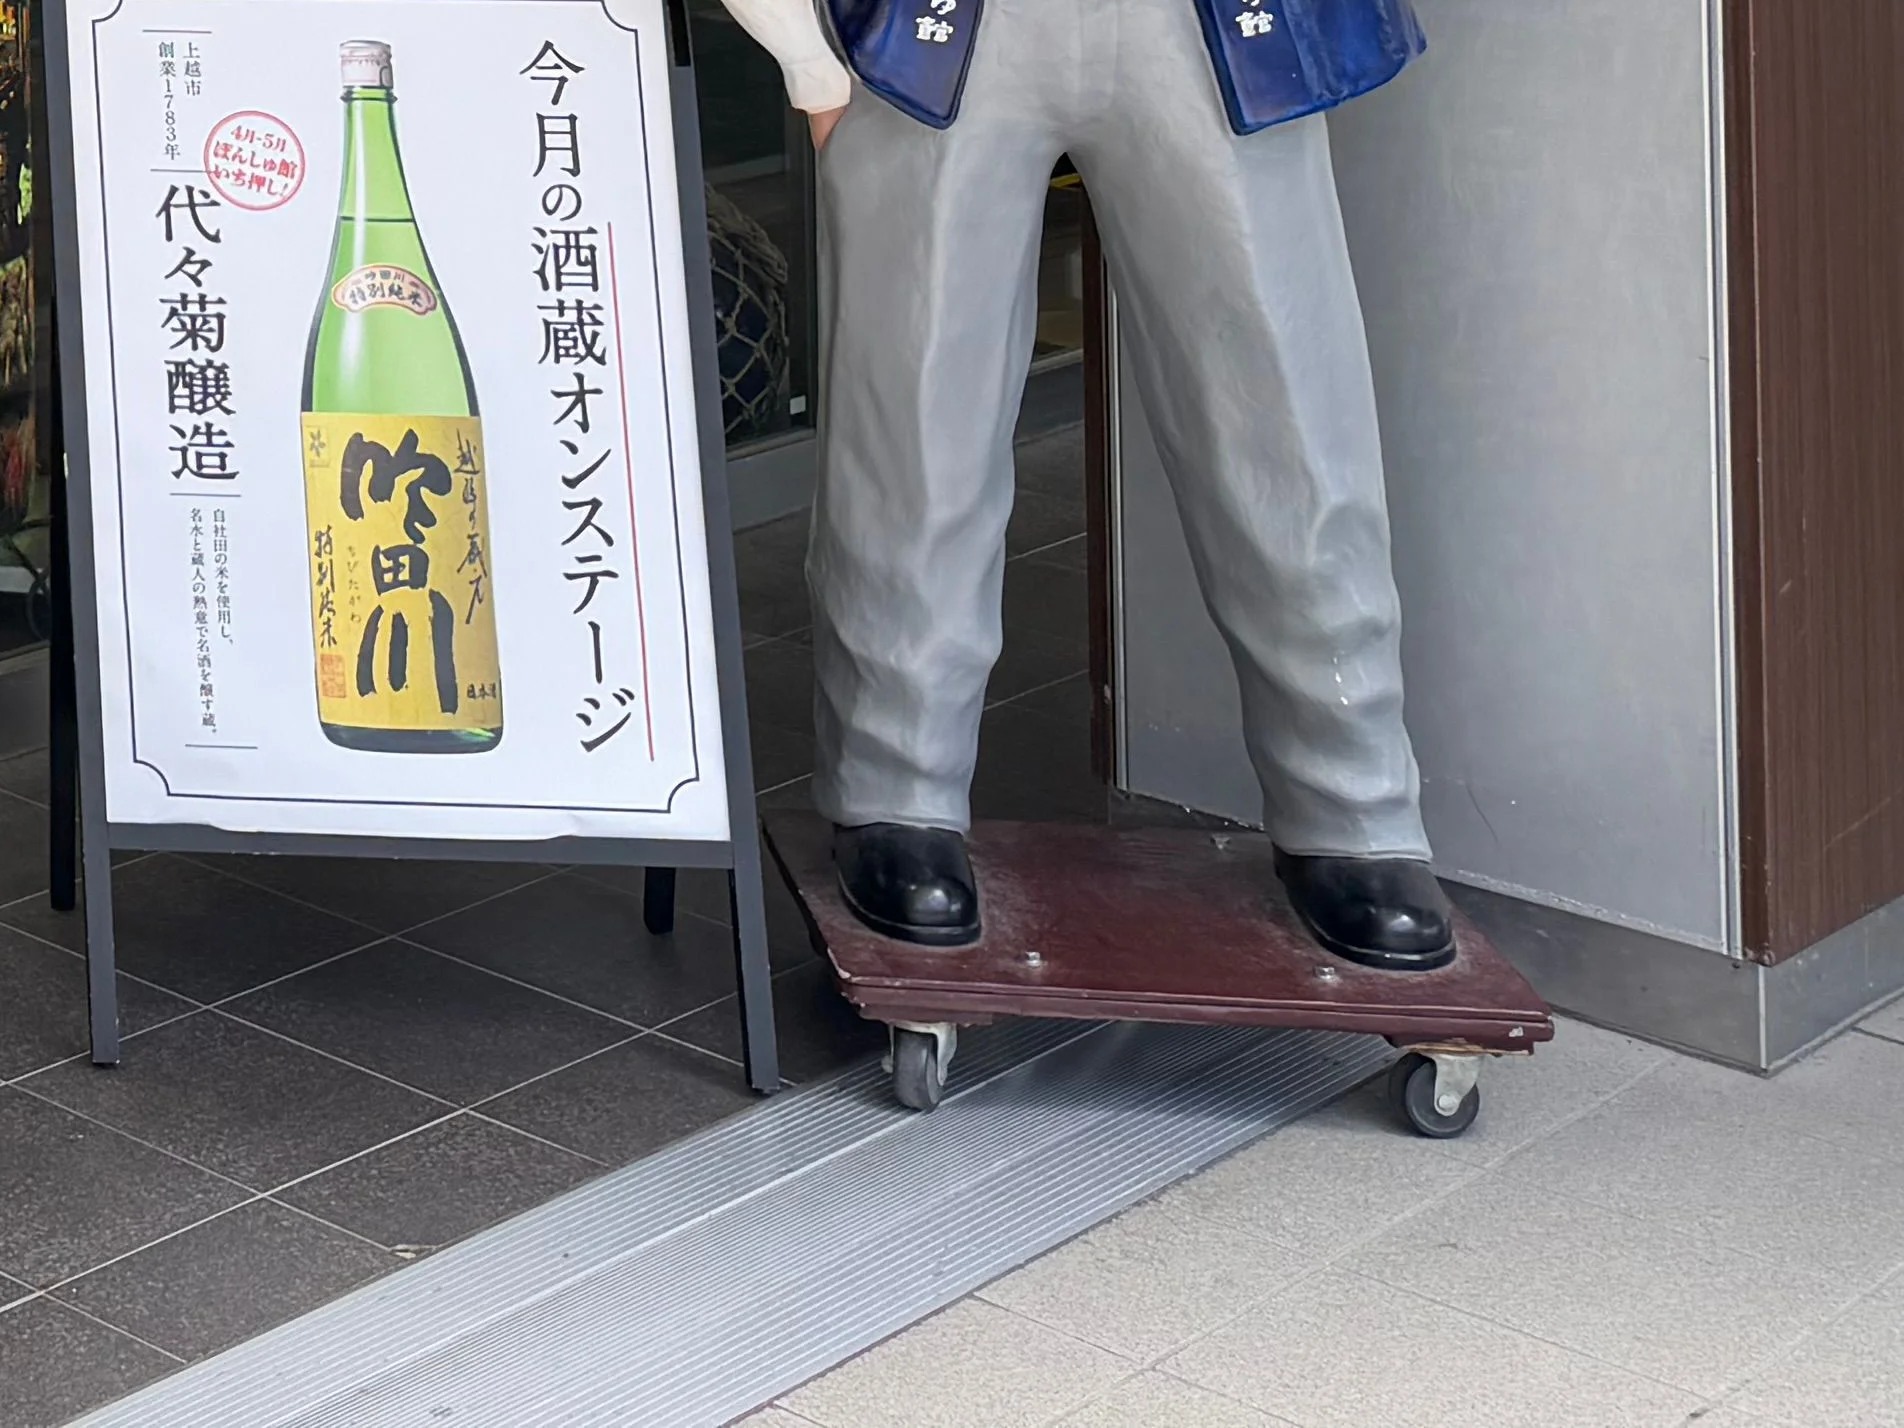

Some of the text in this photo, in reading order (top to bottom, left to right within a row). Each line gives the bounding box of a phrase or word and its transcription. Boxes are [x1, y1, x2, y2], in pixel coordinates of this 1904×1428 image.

[157, 41, 181, 161] 創業1783年
[182, 41, 202, 97] 上越市
[212, 140, 298, 180] ぽんしゅ館
[153, 182, 241, 482] 代々菊醸造
[517, 37, 634, 757] 今月の酒蔵オンステージ
